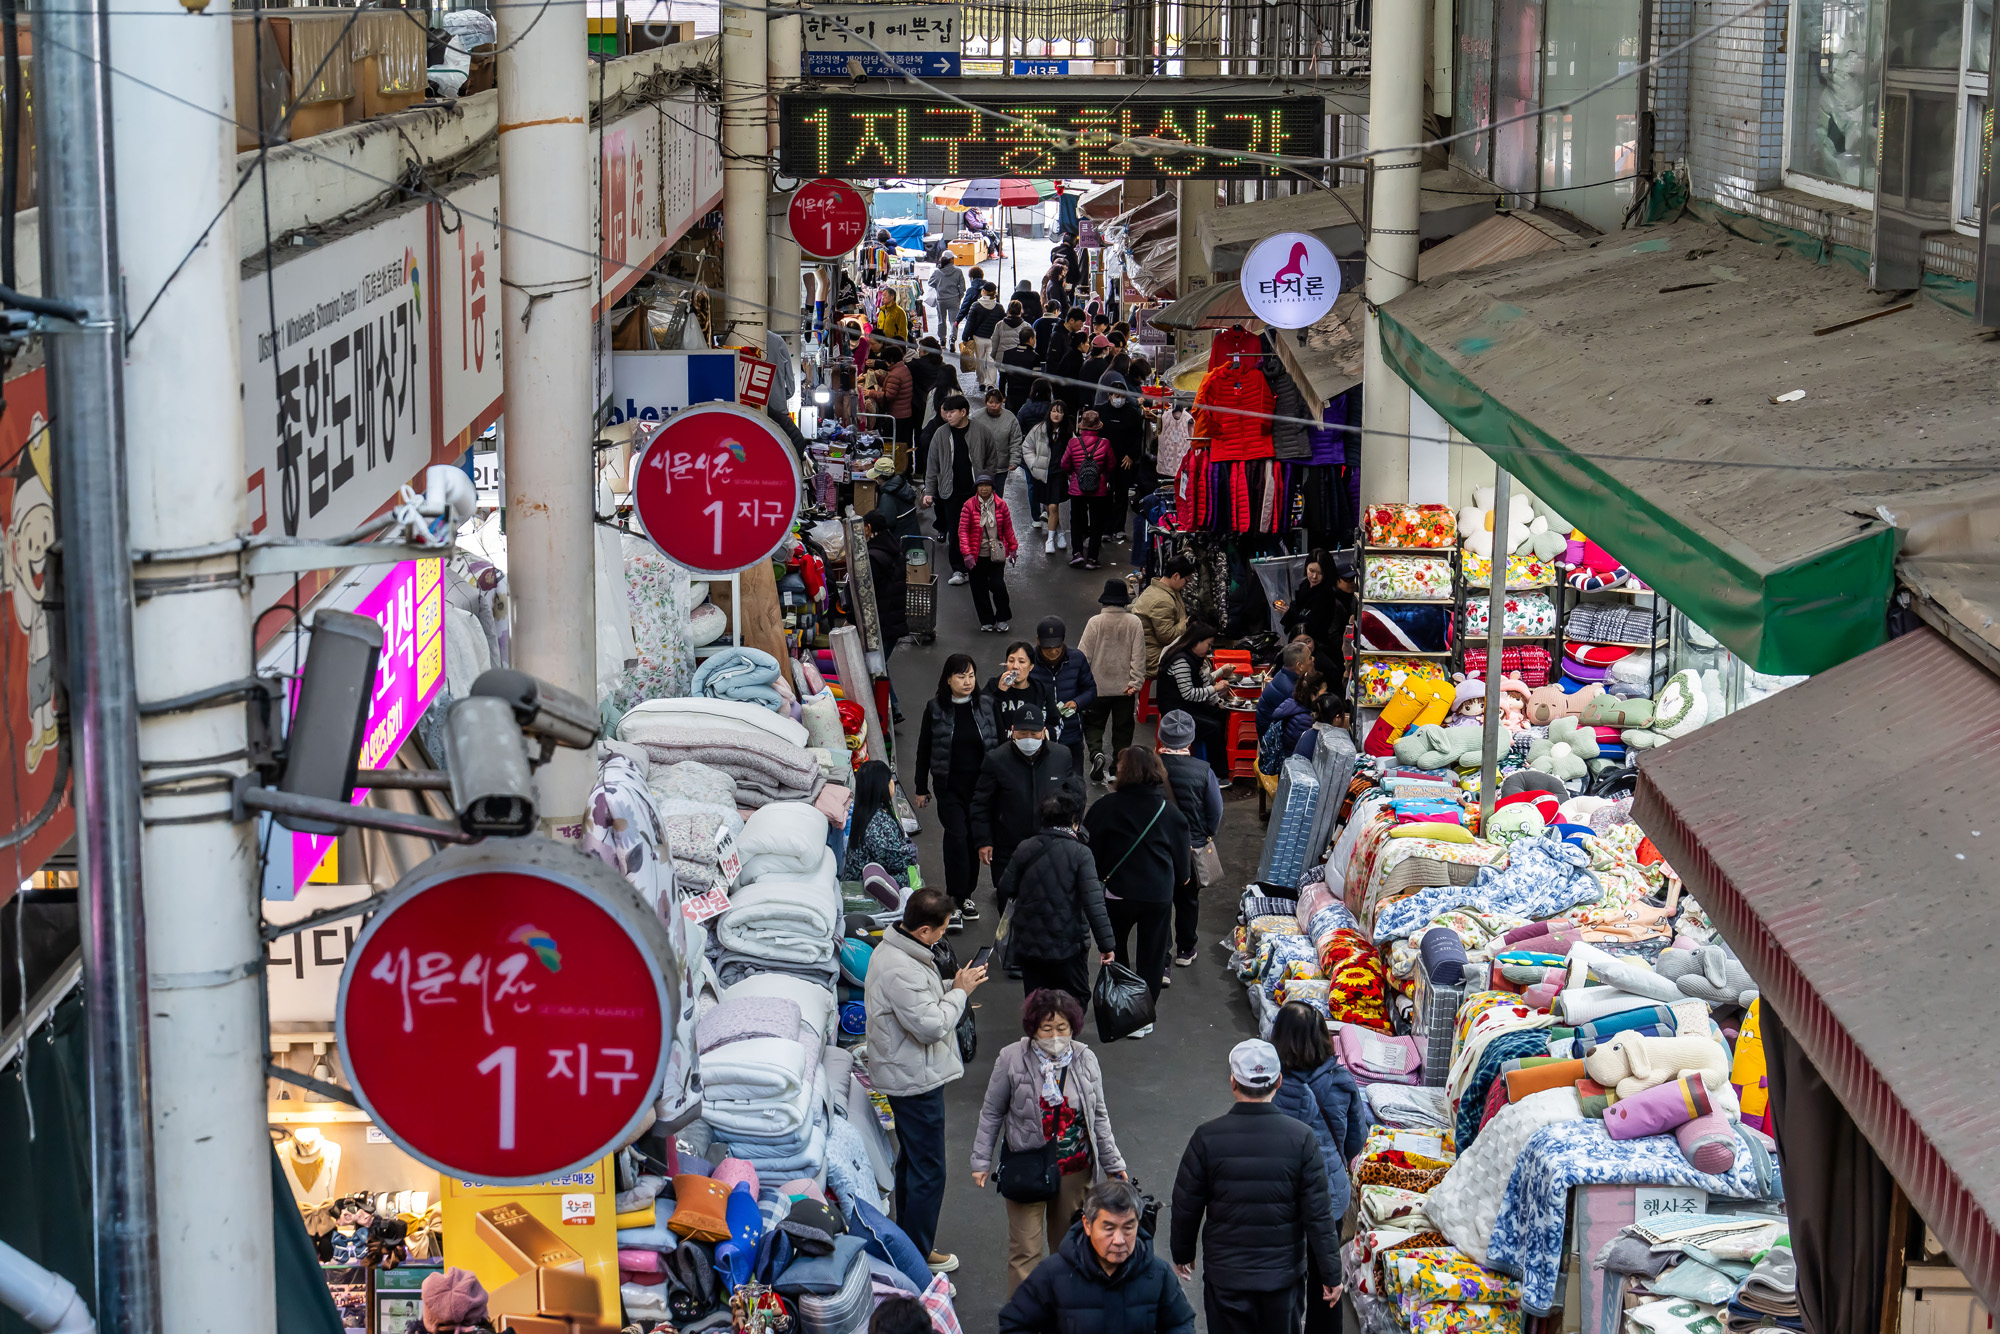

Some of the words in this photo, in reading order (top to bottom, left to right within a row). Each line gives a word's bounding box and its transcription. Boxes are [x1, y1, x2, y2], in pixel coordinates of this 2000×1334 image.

[885, 17, 953, 44] 예쁜집
[821, 222, 832, 250] 1
[838, 221, 861, 235] 지구
[1259, 276, 1325, 298] 타치론
[703, 500, 723, 555] 1
[738, 499, 784, 526] 지구
[476, 1045, 517, 1150] 1
[547, 1042, 640, 1097] 지구
